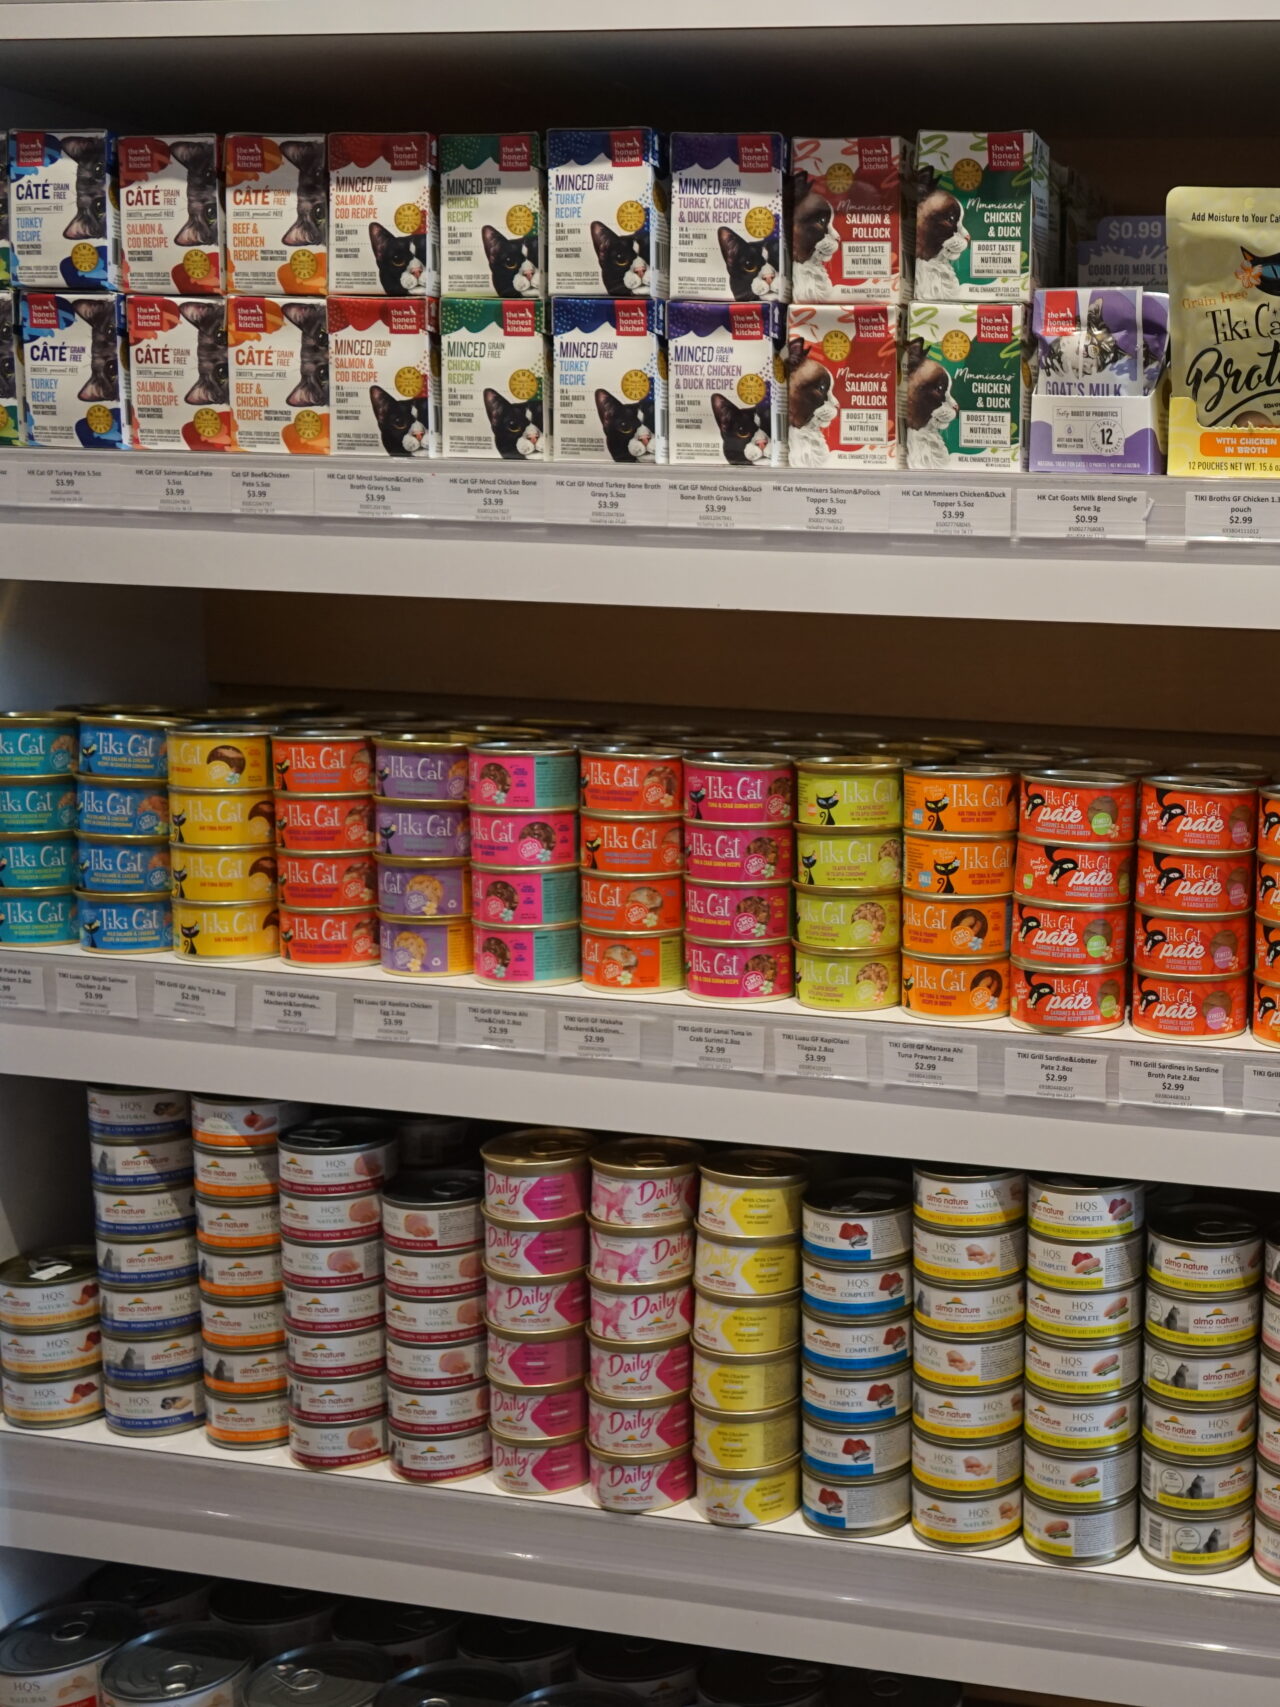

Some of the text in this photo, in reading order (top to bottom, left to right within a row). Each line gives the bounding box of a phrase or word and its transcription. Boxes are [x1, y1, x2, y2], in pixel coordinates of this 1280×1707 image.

[992, 151, 1020, 159] honest
[992, 159, 1020, 167] kitchen
[679, 178, 721, 195] MINCED
[722, 179, 741, 187] GRAIN
[721, 186, 737, 196] FREE
[679, 197, 750, 210] TURKEY, CHICKEN
[16, 217, 43, 228] TURKEY
[679, 212, 742, 223] & DUCK RECIPE
[984, 211, 1021, 223] CHICKEN
[1191, 212, 1206, 222] Add
[1208, 213, 1239, 223] Moisture
[1242, 214, 1249, 222] to
[1251, 213, 1268, 223] Your
[127, 224, 156, 235] SALMON
[232, 223, 250, 234] BEEF
[988, 226, 1021, 238] & DUCK
[1109, 220, 1161, 240] $0.99
[16, 230, 41, 241] RECIPE
[127, 237, 168, 248] COD RECIPE
[233, 237, 265, 248] CHICKEN
[233, 250, 259, 261] RECIPE
[1182, 289, 1248, 309] Grain Free
[1206, 309, 1251, 346] Tiki
[845, 381, 888, 392] SALMON &
[1089, 382, 1123, 396] MILK
[851, 395, 888, 406] POLLOCK
[966, 414, 1005, 423] BOOST TASTE
[969, 427, 1001, 435] NUTRITION
[1101, 428, 1113, 445] 12
[1216, 437, 1277, 446] WITH CHICKEN
[1225, 446, 1268, 454] IN BROTH
[1188, 462, 1196, 470] 12
[1198, 461, 1230, 471] POUCHES
[1231, 462, 1243, 471] NET
[1259, 463, 1273, 472] 15.6
[247, 490, 267, 499] $3.99
[1060, 494, 1079, 502] Goats
[1081, 494, 1095, 502] Milk
[1097, 494, 1115, 502] Blend
[1117, 495, 1137, 504] Single
[1208, 495, 1231, 503] Broths
[1243, 495, 1269, 503] Chicken
[97, 731, 154, 757] Tiki Cat
[705, 776, 763, 800] Tiki Cat
[584, 1035, 604, 1043] $2.99
[1143, 1061, 1157, 1069] Grill
[1158, 1063, 1184, 1071] Sardines
[1161, 1082, 1185, 1092] $2.99
[1075, 1201, 1098, 1212] HQS
[1165, 1258, 1208, 1271] almo nature
[847, 1279, 869, 1289] HQS
[508, 1287, 550, 1314] Daily
[607, 1353, 648, 1380] Daily
